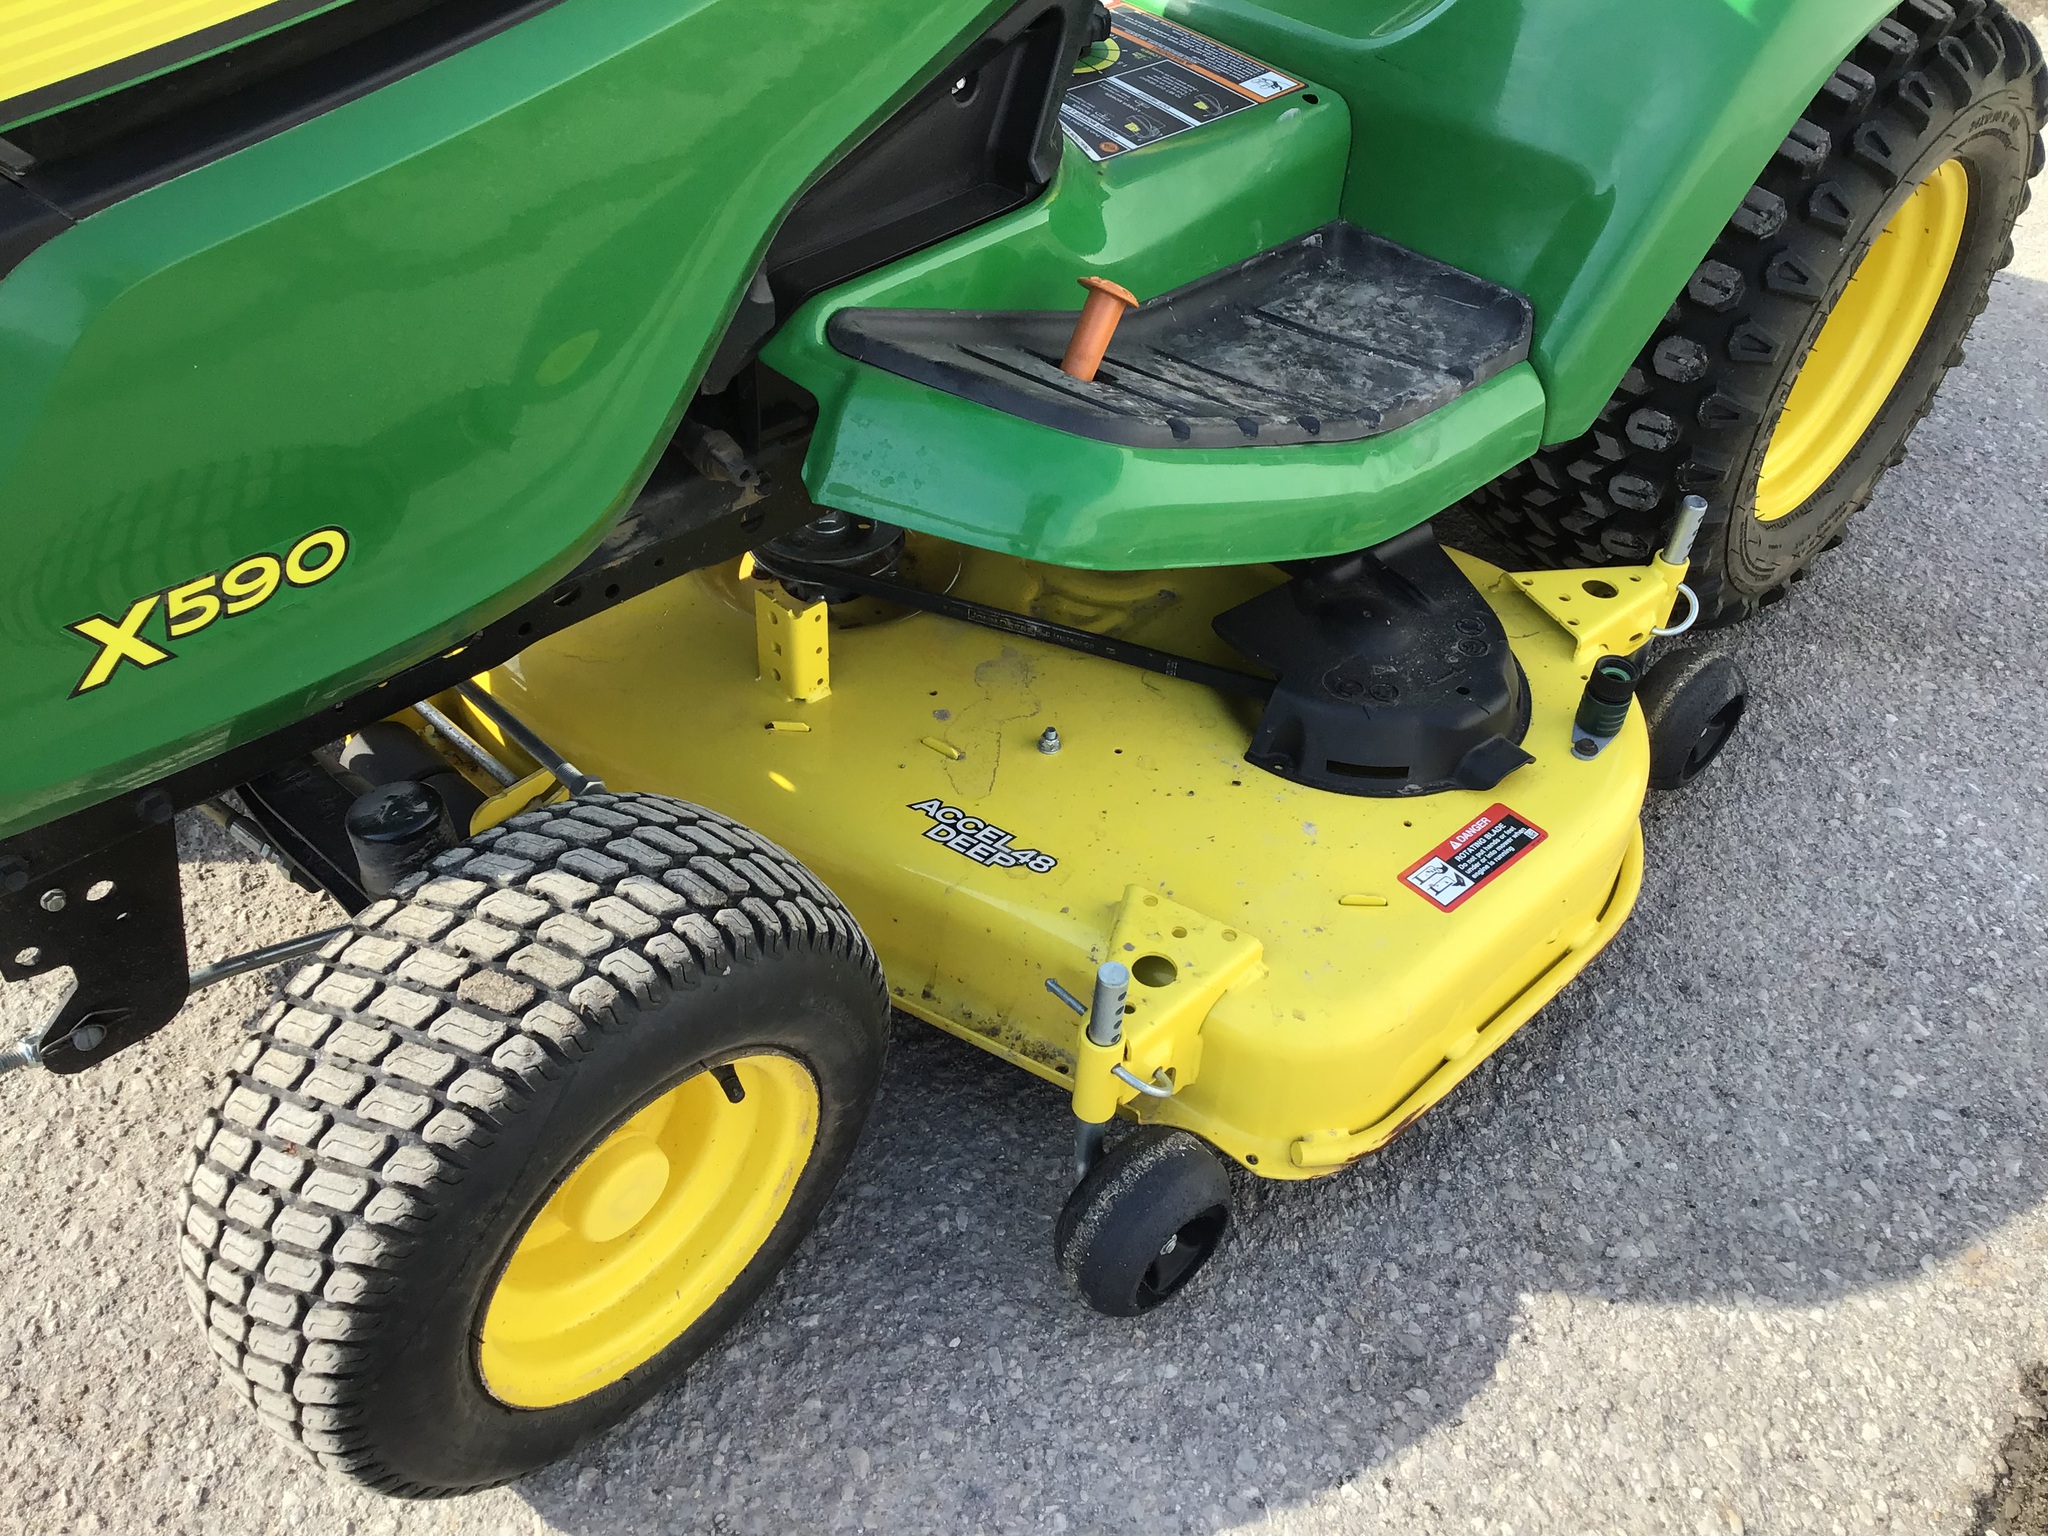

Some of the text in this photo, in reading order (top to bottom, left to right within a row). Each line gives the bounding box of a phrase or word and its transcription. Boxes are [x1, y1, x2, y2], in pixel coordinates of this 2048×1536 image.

[61, 525, 350, 700] X590
[906, 798, 1058, 873] ACCEL 48
[922, 822, 1016, 867] DEEP
[1454, 822, 1506, 862] ROTATING BLADE
[1455, 815, 1491, 843] DANGER
[1457, 861, 1469, 870] Do
[1465, 855, 1477, 864] not
[1474, 848, 1487, 858] put
[1482, 837, 1501, 851] hands
[1503, 825, 1516, 835] feet
[1463, 860, 1482, 874] under
[1484, 848, 1497, 858] into
[1494, 836, 1514, 851] mower
[1510, 826, 1527, 838] when
[1470, 863, 1492, 879] engine
[1491, 845, 1515, 862] running
